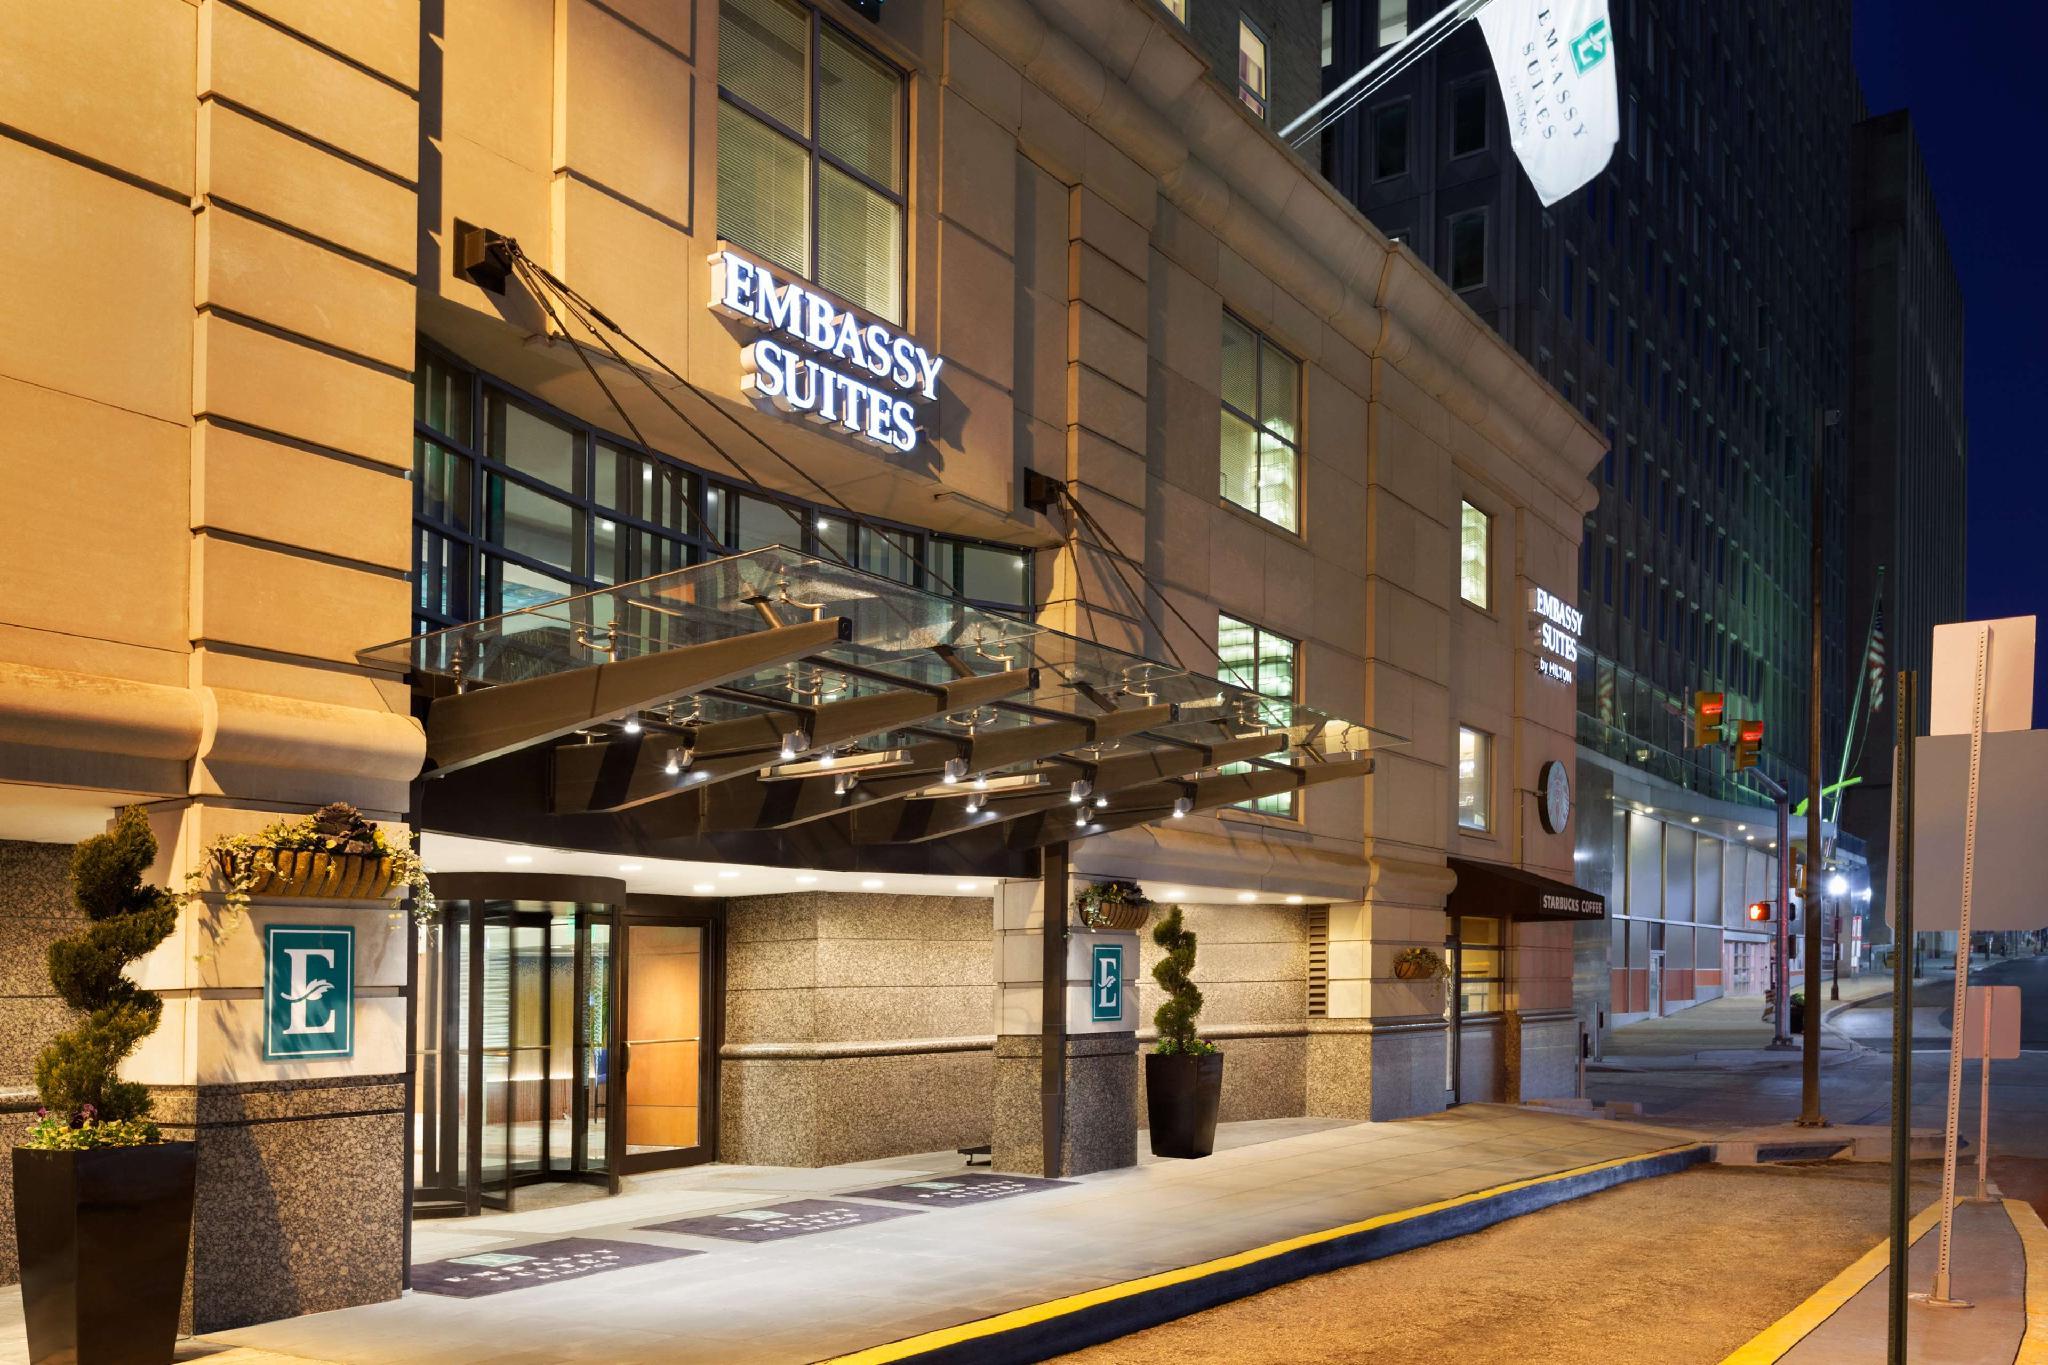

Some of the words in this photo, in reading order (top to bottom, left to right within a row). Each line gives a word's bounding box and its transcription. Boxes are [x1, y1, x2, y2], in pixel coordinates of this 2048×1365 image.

[723, 250, 943, 401] EMBASSY
[755, 338, 917, 452] SUITES
[1536, 587, 1583, 636] EMBASSY
[1542, 622, 1578, 663] SUITES
[1548, 661, 1572, 684] HILTON
[1543, 894, 1580, 912] STARBUCKS
[1581, 900, 1603, 914] COFFEE
